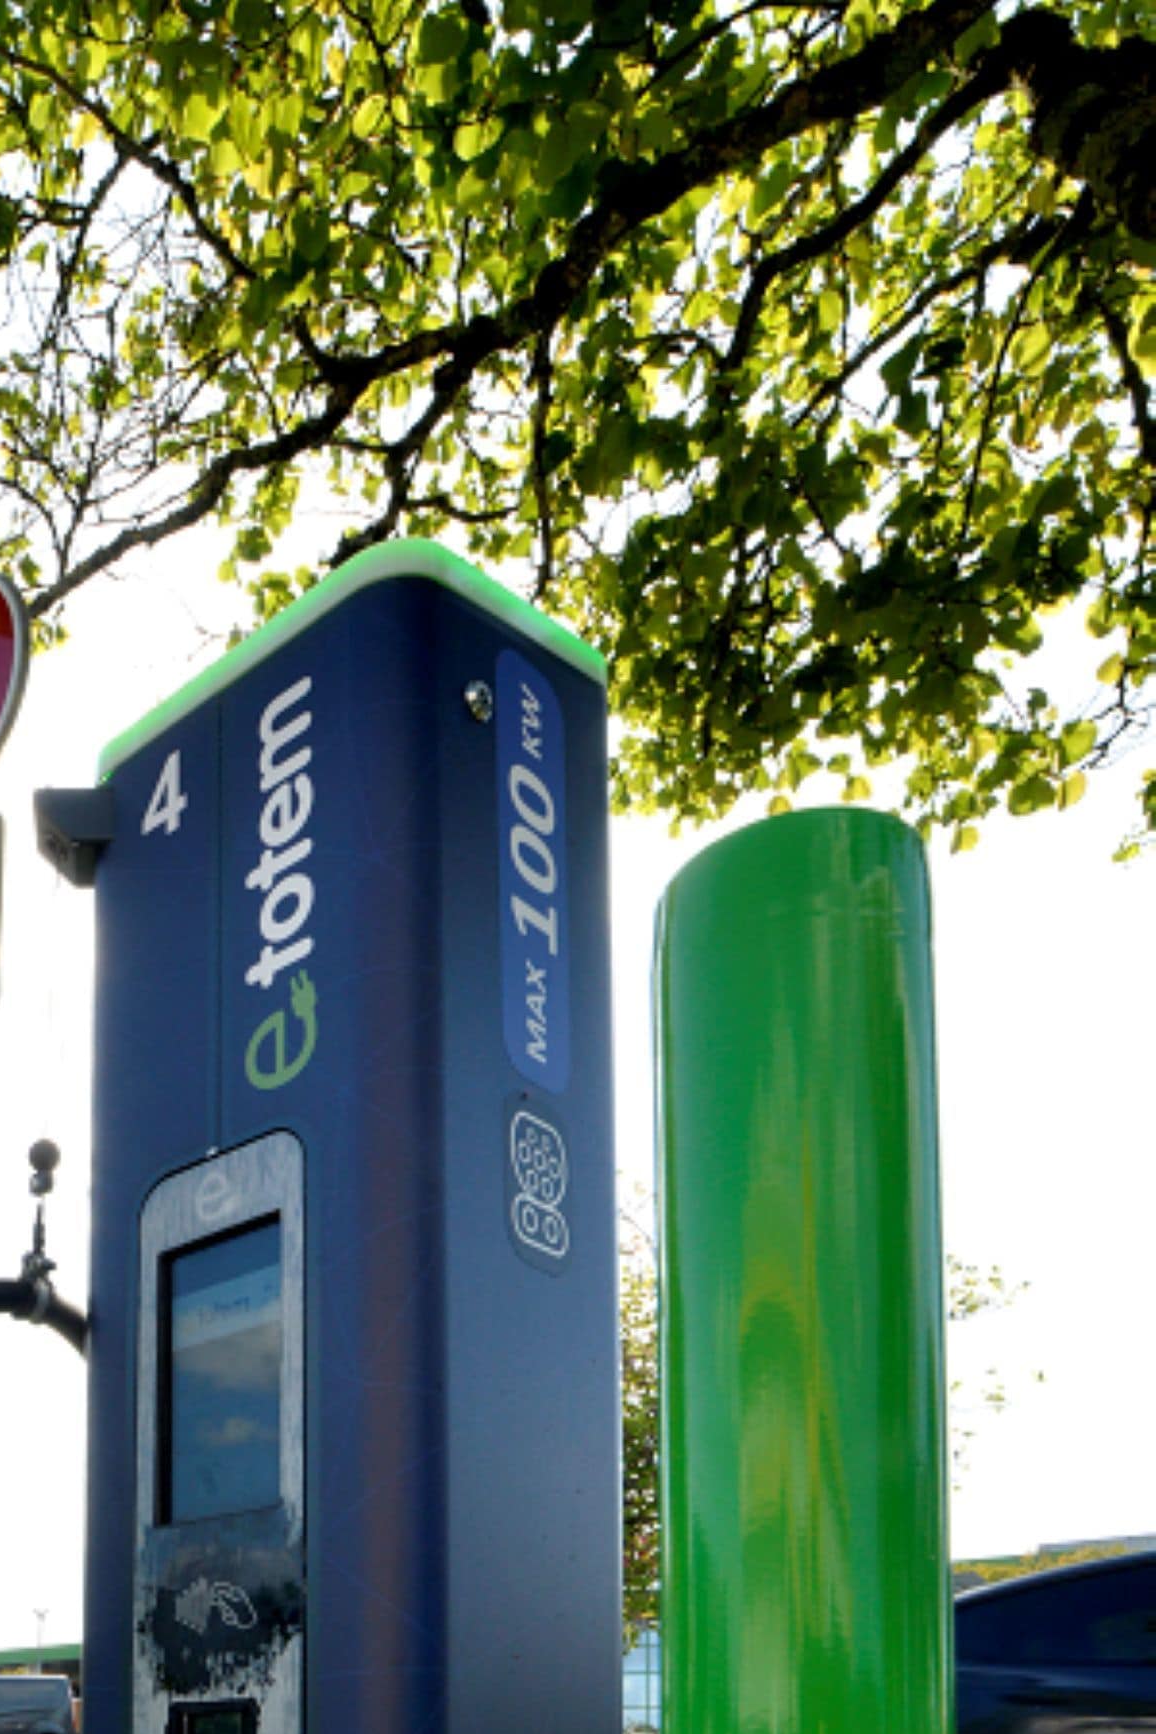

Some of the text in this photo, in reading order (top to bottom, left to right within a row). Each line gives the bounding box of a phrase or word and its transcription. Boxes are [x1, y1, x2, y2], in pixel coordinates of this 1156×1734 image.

[141, 750, 188, 835] 4
[509, 763, 558, 957] 100
[525, 957, 548, 1063] MAX
